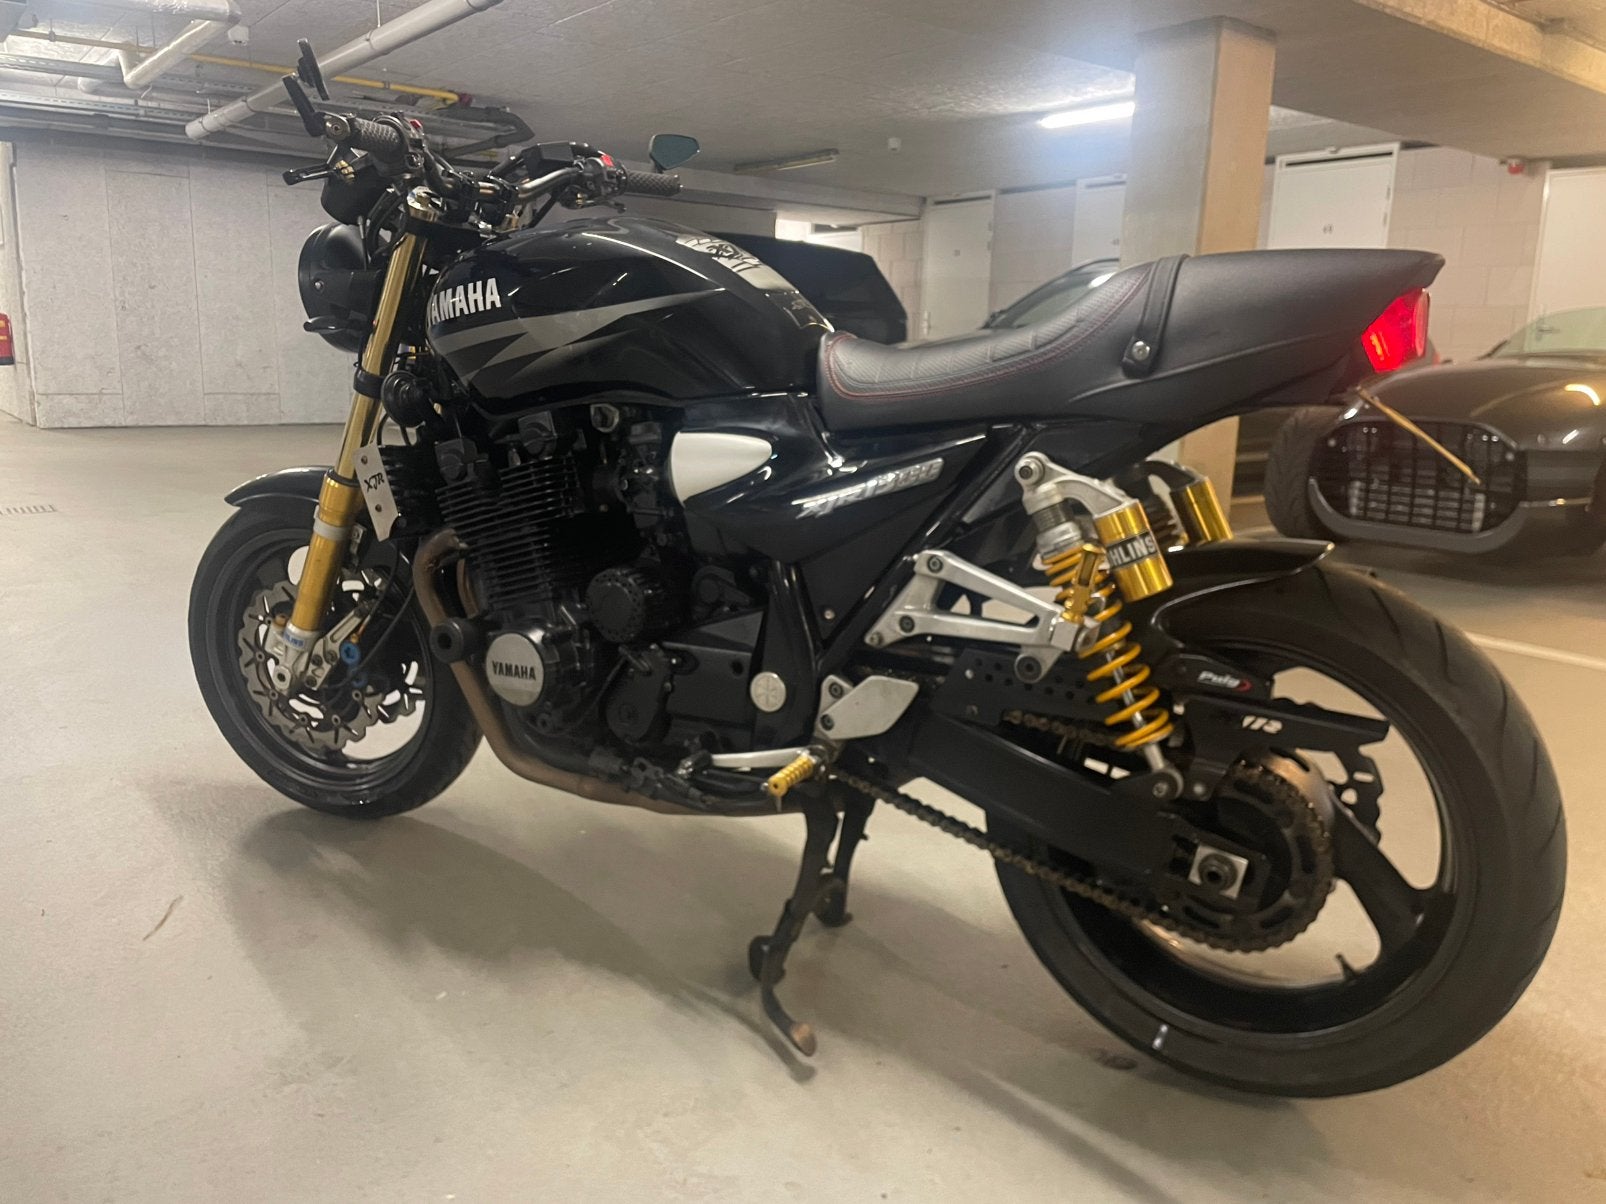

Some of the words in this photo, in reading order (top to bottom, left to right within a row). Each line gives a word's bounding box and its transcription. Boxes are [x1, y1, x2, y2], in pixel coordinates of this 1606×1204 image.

[363, 472, 385, 493] XJR
[1108, 534, 1157, 568] HLINS
[491, 660, 537, 681] YAMAHA
